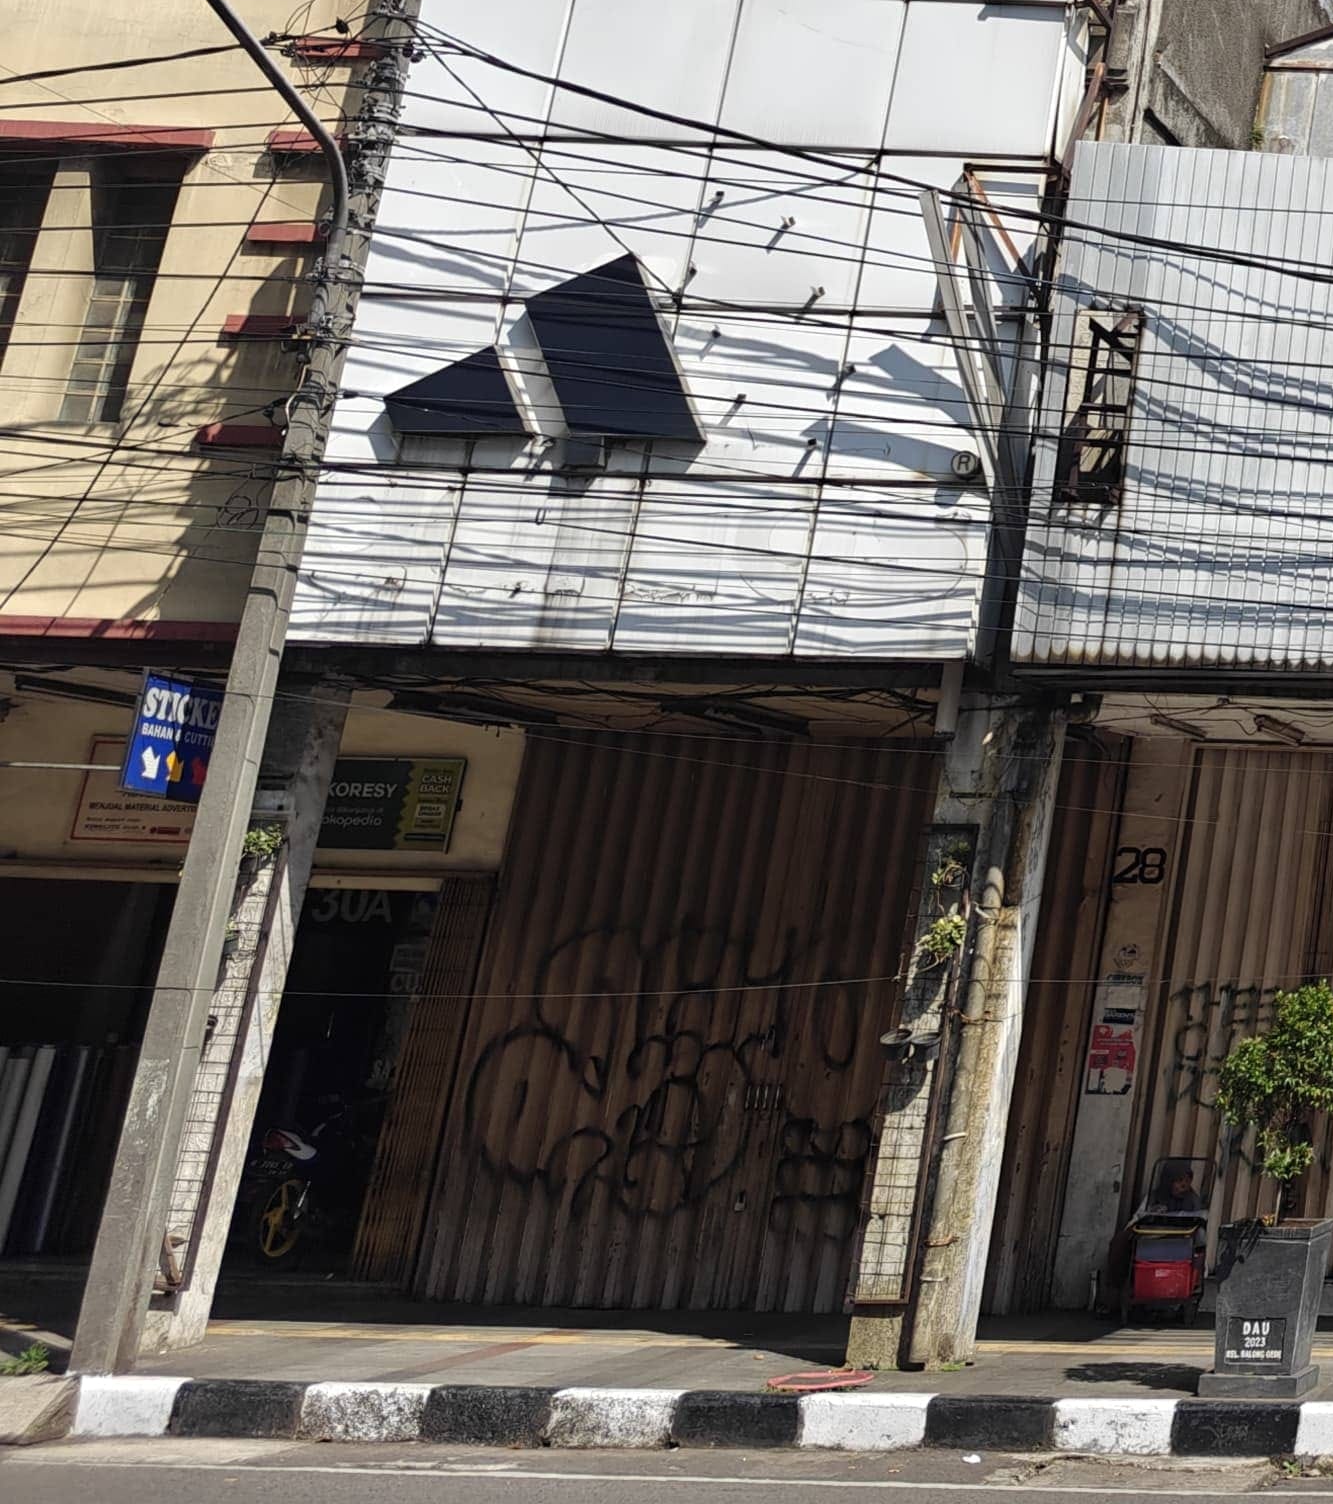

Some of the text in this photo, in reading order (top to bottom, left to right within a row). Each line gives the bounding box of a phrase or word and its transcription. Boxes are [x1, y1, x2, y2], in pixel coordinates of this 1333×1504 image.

[143, 687, 219, 731] STICKE
[142, 722, 174, 741] BAHAN
[422, 775, 453, 784] CASH
[419, 783, 450, 793] BACK
[321, 814, 383, 830] okopedia
[1112, 847, 1167, 884] 28
[1242, 1321, 1271, 1336] DAU
[1244, 1337, 1266, 1348] 2023
